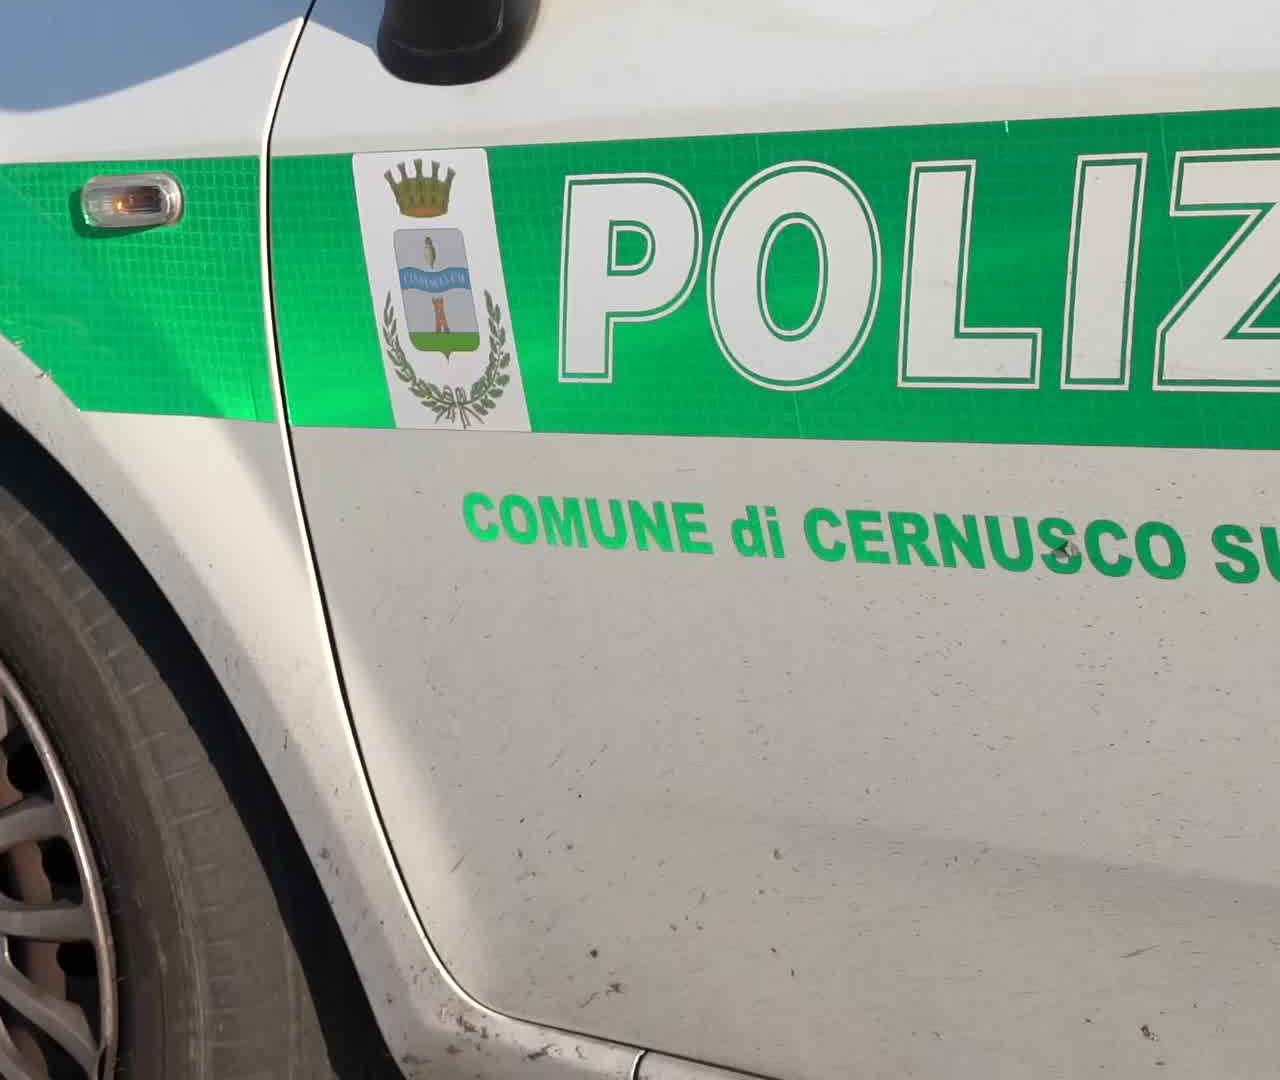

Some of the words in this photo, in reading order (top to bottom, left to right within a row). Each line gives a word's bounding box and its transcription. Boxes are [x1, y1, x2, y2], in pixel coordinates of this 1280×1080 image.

[462, 491, 713, 554] COMUNE
[730, 504, 786, 560] di
[803, 507, 1188, 581] CERNUSCO
